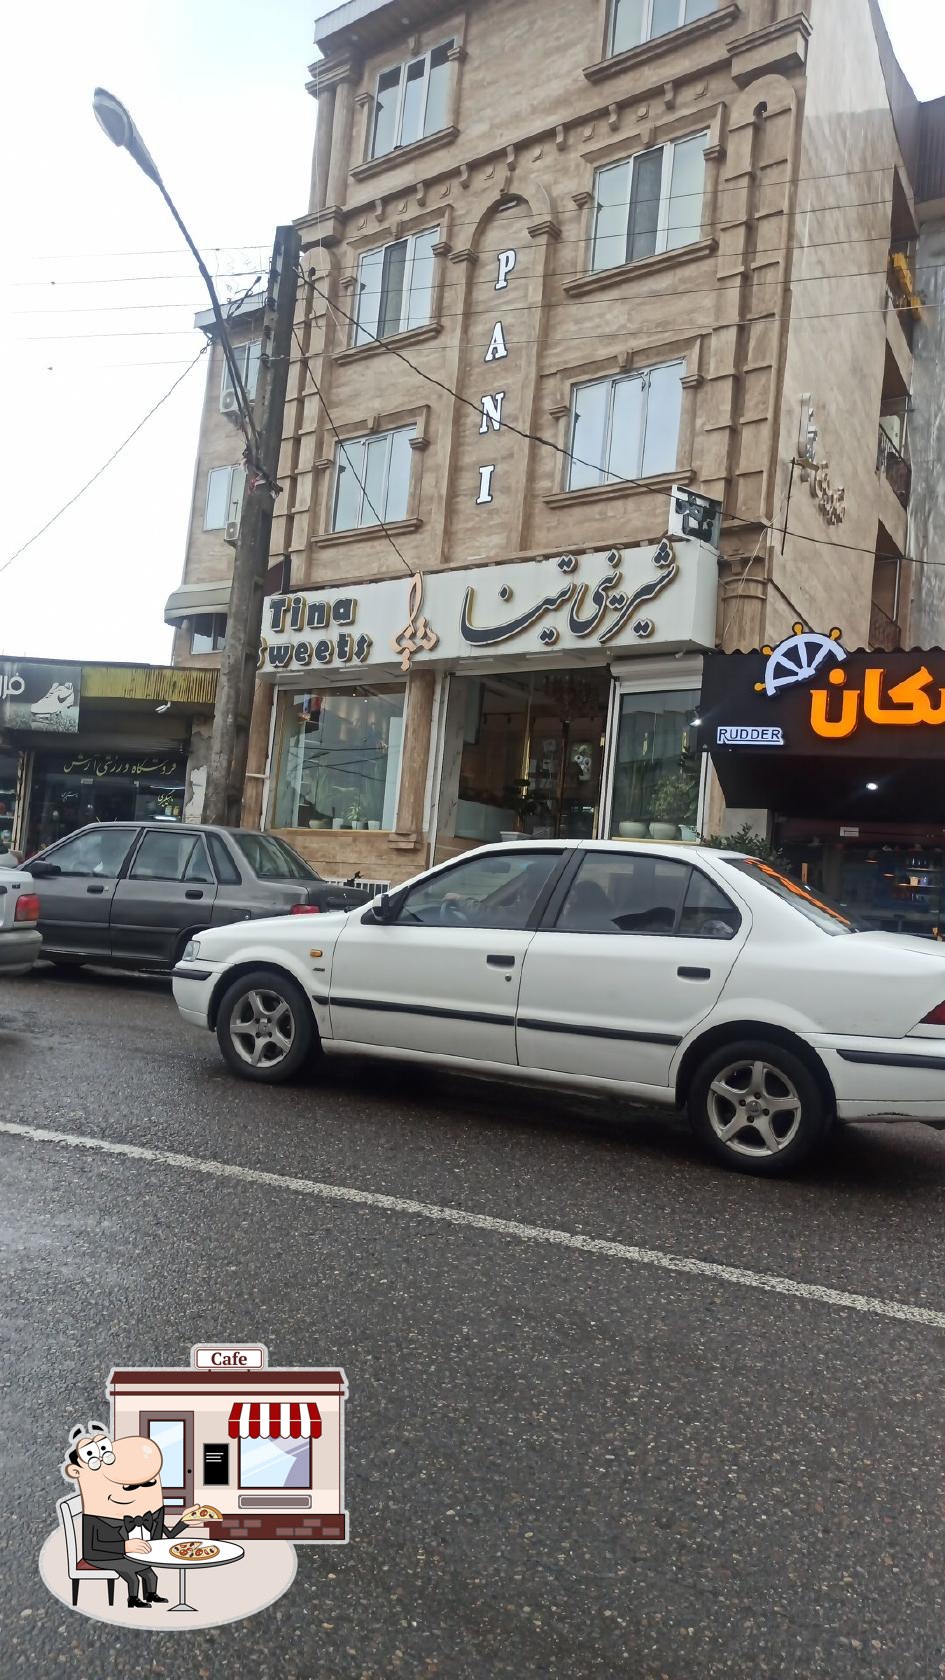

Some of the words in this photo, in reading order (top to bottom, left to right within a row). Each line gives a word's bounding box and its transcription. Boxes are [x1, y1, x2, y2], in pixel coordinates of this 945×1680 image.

[460, 553, 578, 647] تینا
[568, 539, 679, 644] شیرینی
[270, 596, 357, 634] Tina
[717, 728, 782, 744] RUDDER
[63, 754, 97, 774] آرش
[95, 755, 130, 777] ورزشی
[130, 758, 177, 775] فروشگاه
